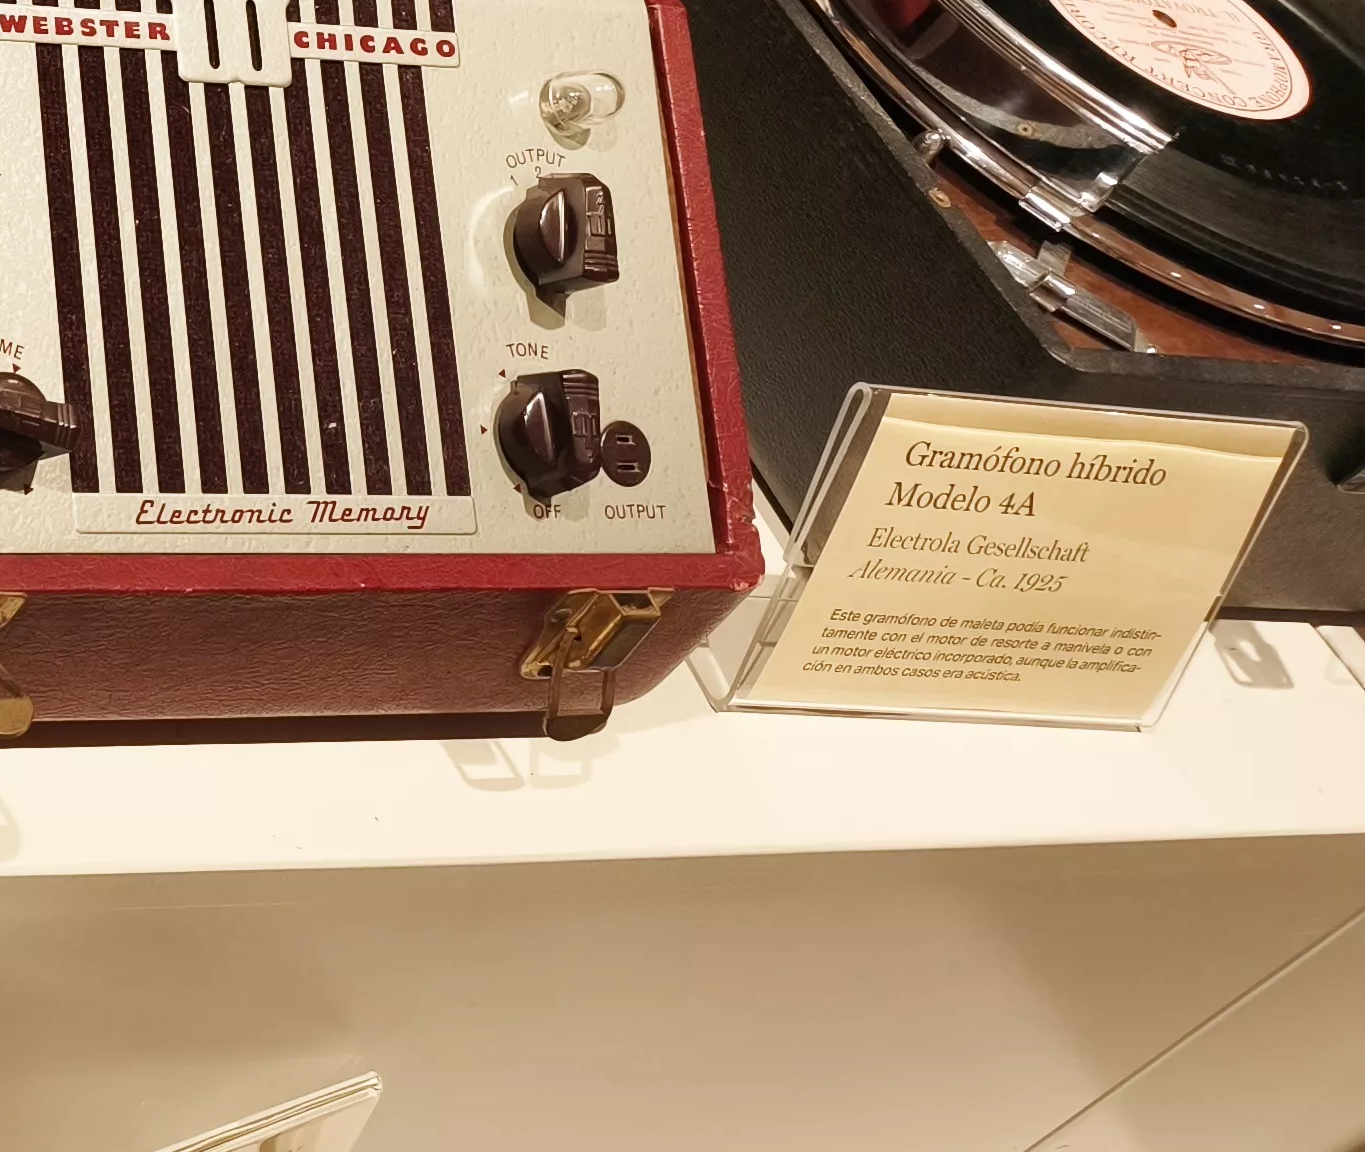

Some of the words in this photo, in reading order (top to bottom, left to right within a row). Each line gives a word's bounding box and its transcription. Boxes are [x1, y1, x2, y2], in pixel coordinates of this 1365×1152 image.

[294, 29, 457, 59] CHICAGO
[505, 148, 566, 169] OUTPUT
[533, 165, 543, 179] 2
[505, 342, 549, 360] TONE
[905, 440, 1062, 479] Gramófono
[1066, 452, 1168, 487] híbrido
[533, 504, 561, 519] OFF
[604, 504, 667, 520] OUTPUT
[884, 482, 992, 516] Modelo
[999, 490, 1037, 517] 4A
[134, 500, 295, 527] Electronic
[307, 500, 431, 531] Memory
[866, 527, 961, 555] Electrola
[966, 534, 1091, 563] Gesellschaft
[847, 559, 957, 586] Alemania
[975, 568, 1008, 590] Ca.
[1013, 572, 1069, 593] 1925
[830, 608, 861, 622] Este
[863, 612, 937, 629] gramófono
[939, 615, 957, 628] de
[960, 618, 1004, 631] maleta
[1005, 620, 1045, 635] podía
[1047, 622, 1108, 639] funcionar
[1110, 626, 1163, 641] indistin-
[821, 627, 877, 641] tamente
[881, 632, 906, 643] con
[910, 632, 923, 643] el
[926, 635, 968, 646] motor
[970, 635, 988, 647] de
[990, 637, 1038, 650] resorte
[1041, 641, 1051, 651] a
[1053, 640, 1111, 655] manivela
[1114, 646, 1124, 655] o
[1127, 647, 1153, 657] con
[802, 660, 832, 673] ción
[834, 663, 852, 674] en
[853, 664, 899, 677] ambos
[901, 667, 941, 678] casos
[942, 669, 964, 679] era
[965, 668, 1021, 682] acústica.
[812, 645, 829, 655] un
[831, 646, 873, 658] motor
[874, 647, 932, 661] eléctrico
[933, 649, 1014, 666] incorporado,
[1015, 655, 1065, 670] aunque
[1067, 657, 1078, 669] la
[1079, 658, 1142, 673] amplifica-
